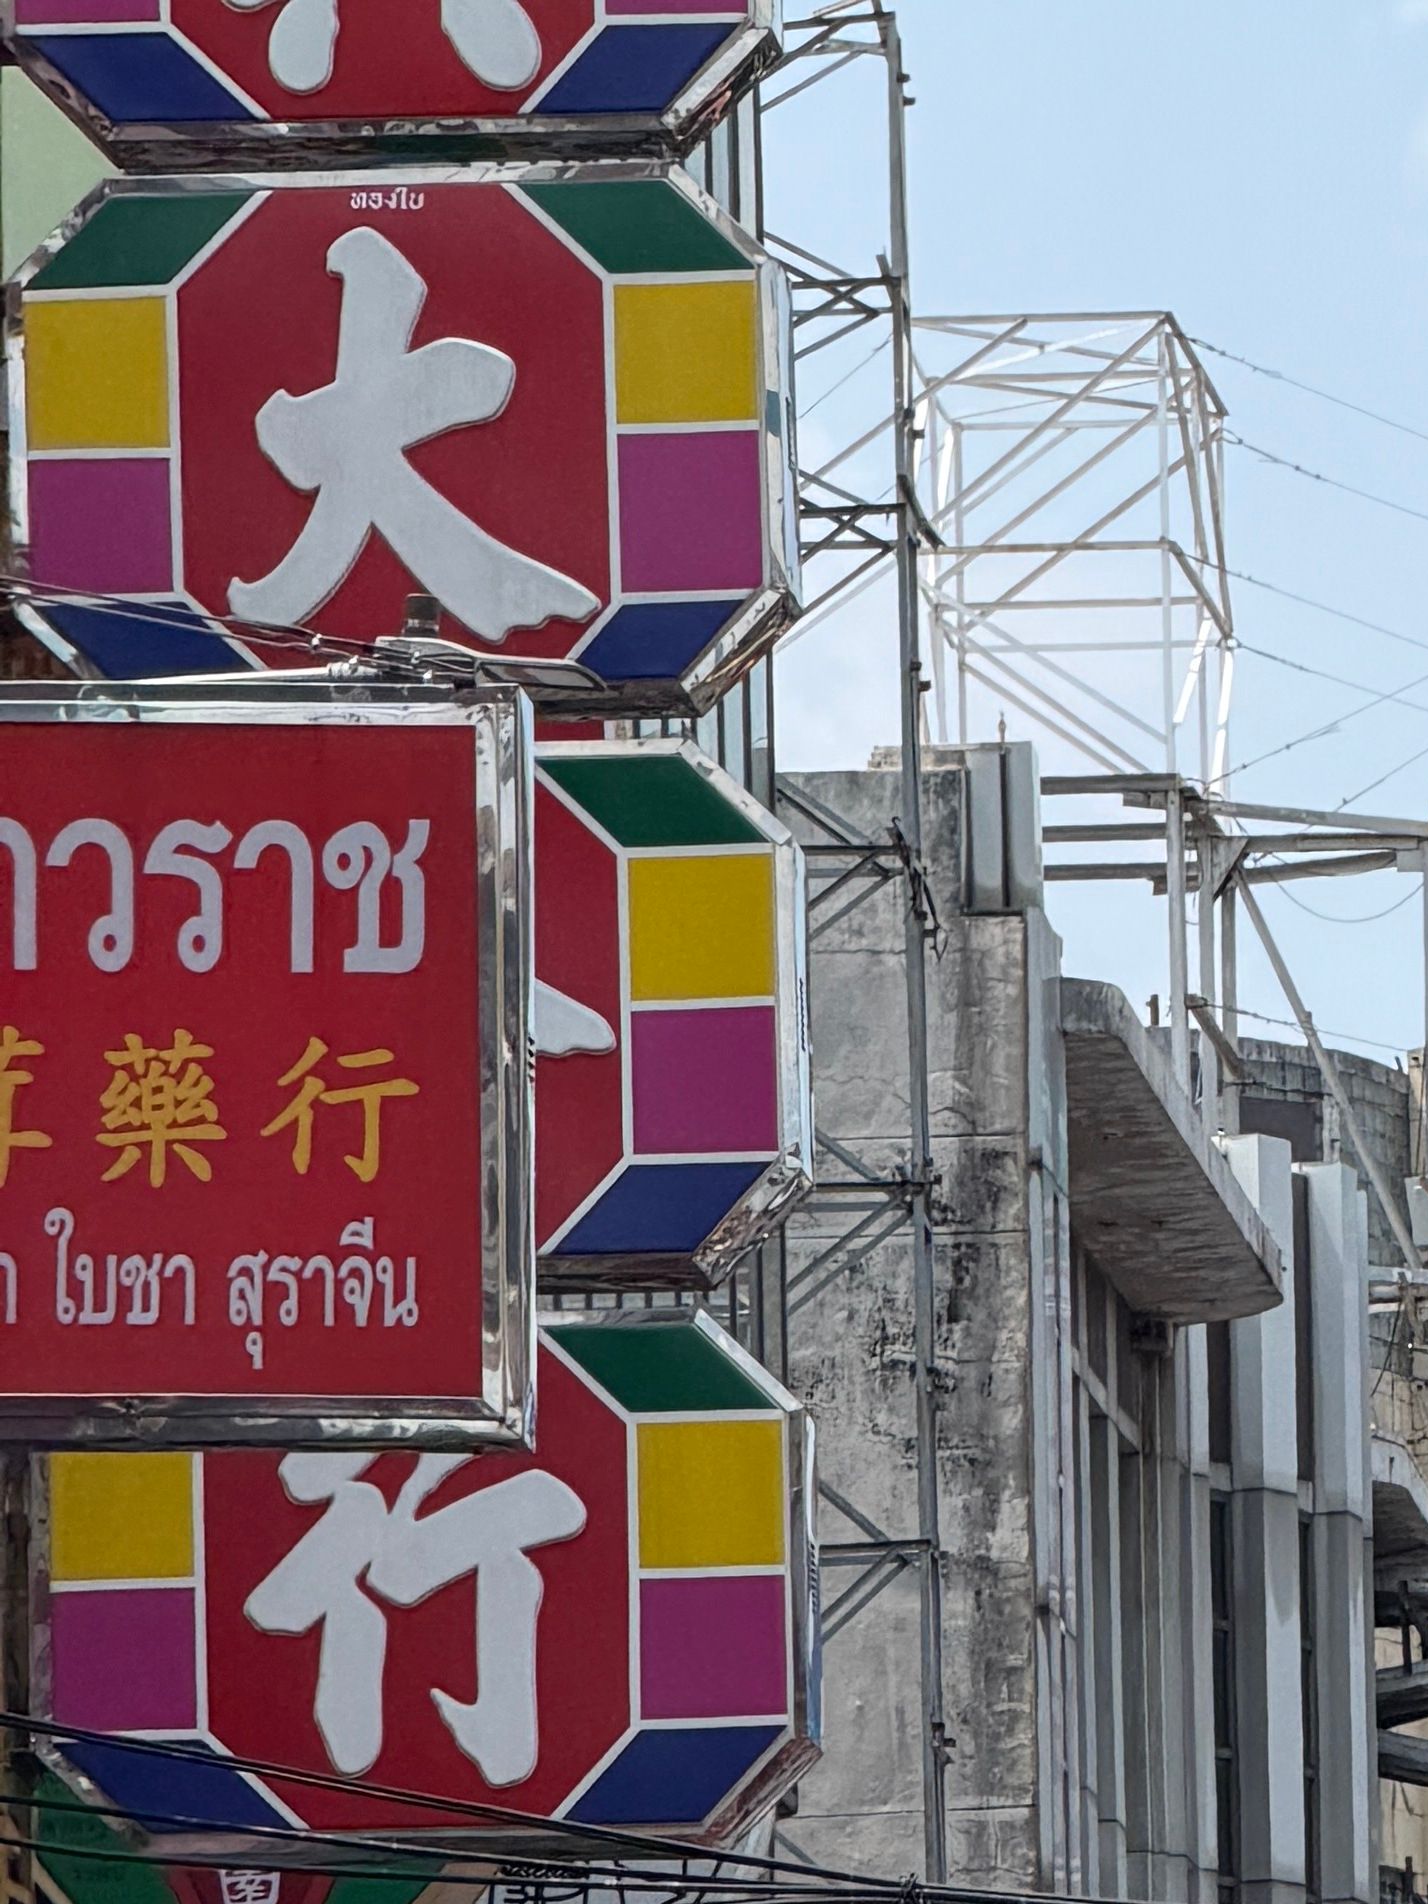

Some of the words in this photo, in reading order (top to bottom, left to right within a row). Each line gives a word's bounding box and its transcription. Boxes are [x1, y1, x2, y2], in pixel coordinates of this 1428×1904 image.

[350, 187, 425, 211] ทองใบ
[228, 226, 600, 643] 大
[44, 1208, 196, 1327] ใบชา
[228, 1217, 419, 1369] สุราจีน
